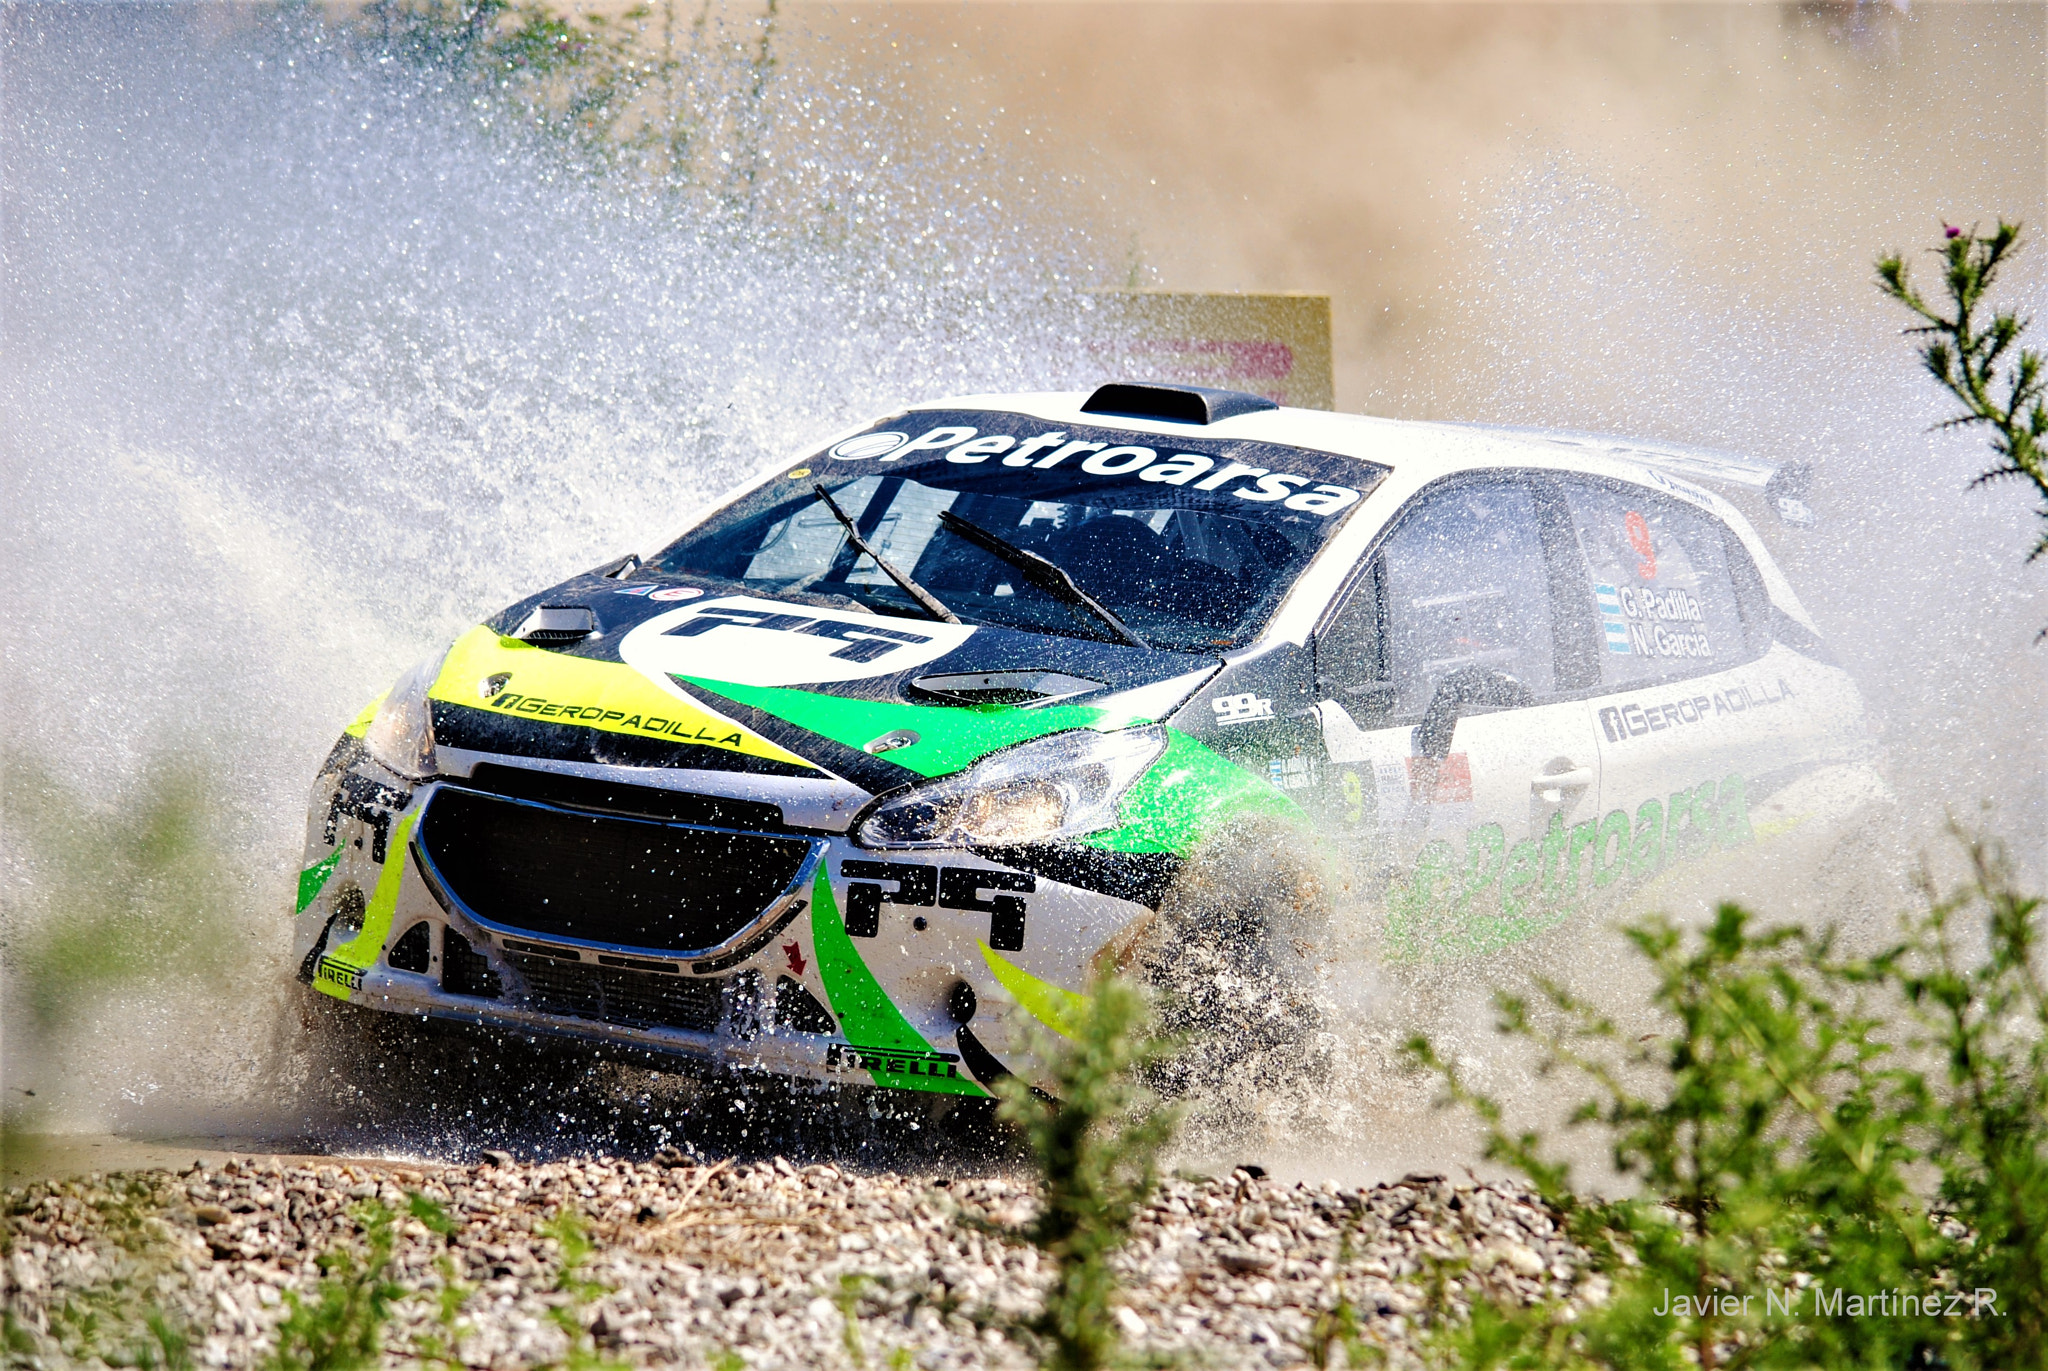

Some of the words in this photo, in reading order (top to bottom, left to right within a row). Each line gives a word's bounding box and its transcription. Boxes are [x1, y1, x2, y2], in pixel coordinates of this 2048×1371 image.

[880, 426, 1361, 516] Petroarsa
[1625, 511, 1657, 580] 9
[1620, 586, 1643, 617] G.
[1641, 588, 1702, 621] Padilla
[1630, 623, 1653, 655] N.
[516, 698, 742, 747] GEROPADILLA
[1621, 678, 1795, 737] GEROPADILLA
[1342, 771, 1363, 822] 9
[1462, 773, 1754, 918] Petroarsa
[826, 1043, 961, 1079] PIRELLI
